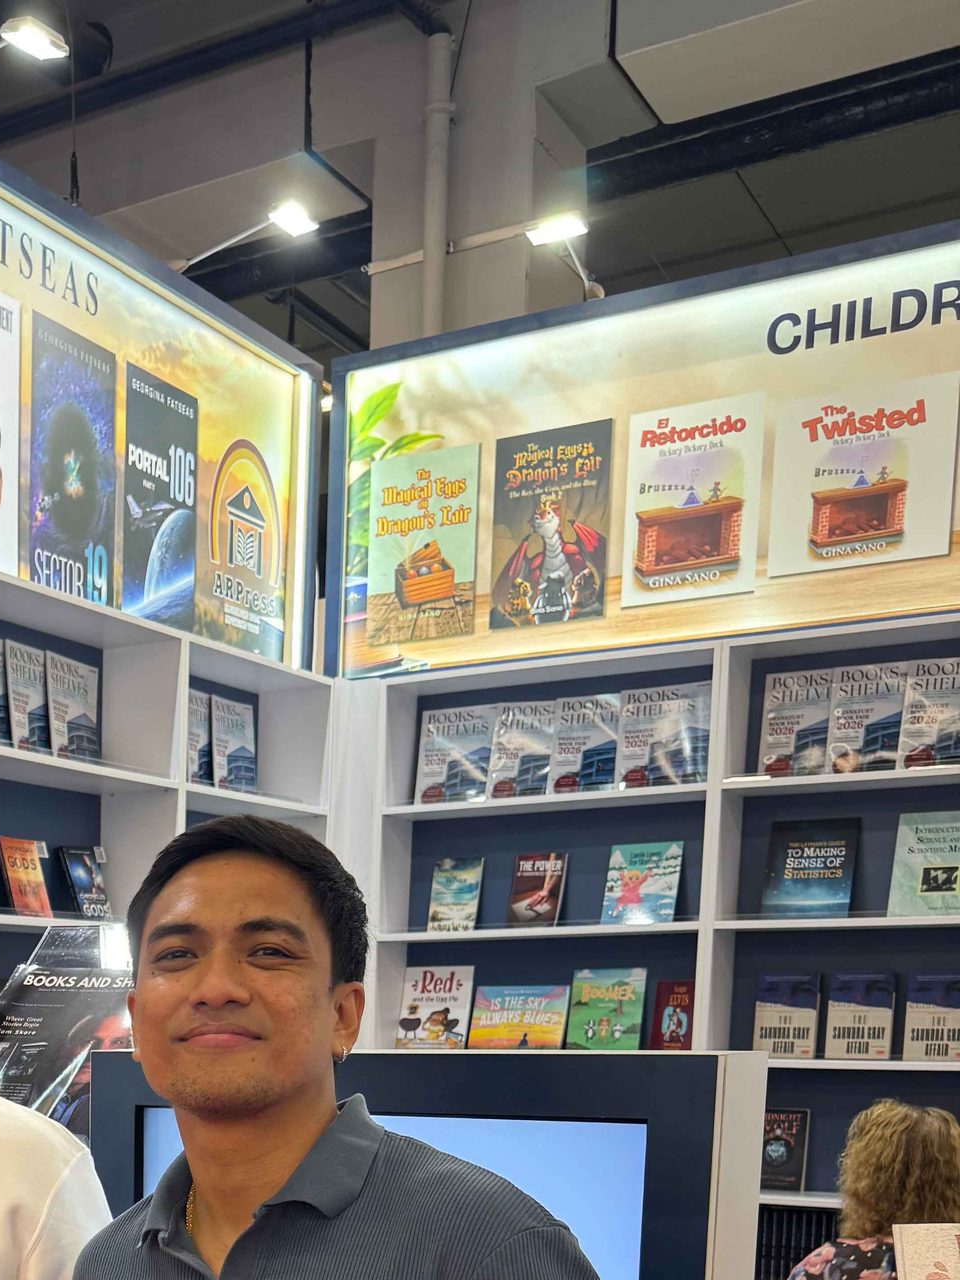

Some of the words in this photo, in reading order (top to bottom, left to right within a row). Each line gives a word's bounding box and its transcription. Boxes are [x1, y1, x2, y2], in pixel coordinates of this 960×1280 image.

[131, 377, 165, 404] GEORGINA
[166, 396, 194, 419] FATSEAS
[821, 405, 847, 417] The
[657, 418, 670, 430] El
[801, 399, 926, 442] Twisted
[640, 415, 747, 448] Retorcido
[556, 443, 583, 461] Eggs
[128, 443, 170, 484] PORTAL
[168, 443, 196, 507] 106
[416, 468, 431, 481] The
[381, 480, 433, 507] Magical
[434, 476, 467, 499] Eggs
[376, 510, 435, 537] Dragon's
[440, 504, 472, 527] Lair
[822, 545, 853, 558] GINA
[855, 541, 887, 555] SANO
[33, 548, 84, 598] SECTOR
[84, 542, 108, 608] 19
[649, 574, 682, 589] GINA
[685, 570, 721, 584] SANO
[212, 572, 276, 616] ARPress
[50, 656, 80, 679] BOOKS
[840, 665, 899, 683] BOOKS
[771, 673, 829, 690] BOOKS
[627, 688, 680, 705] BOOKS
[428, 709, 475, 725] BOOKS
[909, 714, 938, 725] 2026
[426, 721, 489, 738] SHELVES
[768, 727, 795, 737] 2026
[835, 720, 864, 731] 2026
[558, 746, 582, 755] 2026
[624, 739, 649, 749] 2026
[424, 757, 447, 767] 2026
[787, 849, 802, 858] TO
[803, 847, 846, 857] MAKING
[7, 855, 38, 871] GODS
[519, 861, 533, 872] THE
[533, 860, 562, 871] POWER
[785, 858, 825, 869] SENSE
[826, 857, 845, 868] OF
[784, 869, 843, 880] STATISTICS
[23, 975, 77, 988] BOOKS
[77, 976, 112, 988] AND
[420, 970, 456, 994] Red
[580, 983, 636, 1004] BOOMER
[490, 998, 500, 1011] IS
[504, 996, 524, 1009] THE
[525, 997, 550, 1011] SKY
[479, 1010, 520, 1027] ALWAYS
[792, 1026, 810, 1040] GRAY
[866, 1026, 885, 1039] GRAY
[772, 1041, 795, 1055] AFFAIR
[845, 1041, 870, 1055] AFFAIR
[924, 1043, 950, 1057] AFFAIR
